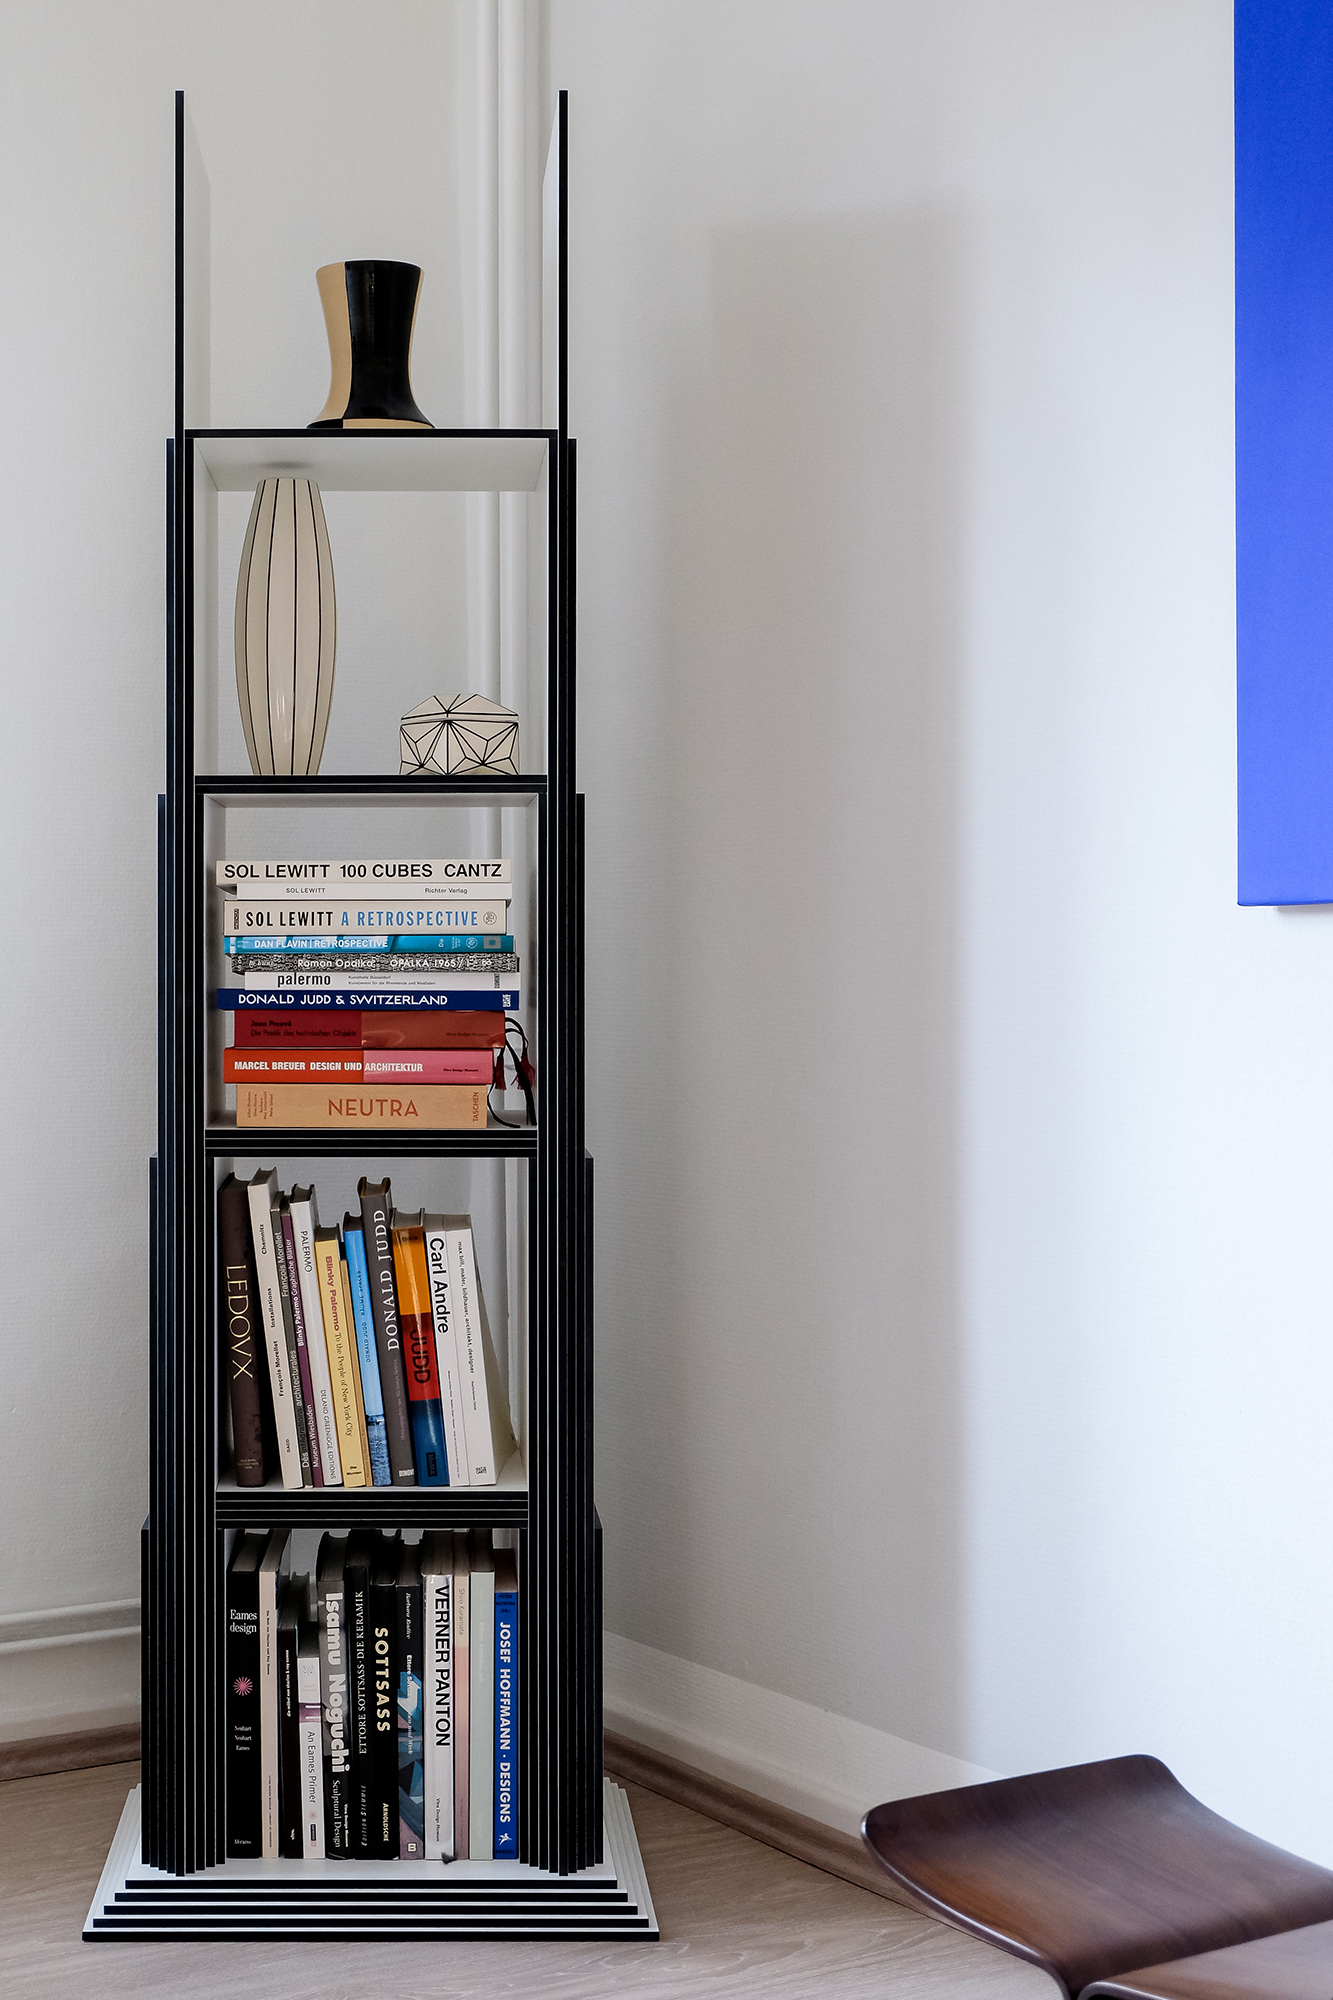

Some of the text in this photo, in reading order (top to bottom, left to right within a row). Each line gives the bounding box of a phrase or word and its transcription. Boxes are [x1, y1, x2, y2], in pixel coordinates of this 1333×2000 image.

[224, 863, 502, 878] SOL LEWITT 100 CUBES CANTZ
[448, 887, 468, 895] Verlag
[245, 911, 274, 927] SOL
[279, 911, 334, 927] LEWITT
[341, 911, 350, 926] A
[357, 910, 479, 926] RETROSPECTIVE
[254, 940, 275, 949] DAN
[275, 940, 310, 949] FLAVIN
[314, 939, 389, 948] RETROSPECTIVE
[297, 958, 374, 969] Roman Opalka
[390, 959, 430, 968] OPALKA
[238, 994, 448, 1006] DONALD JUDD & SWITZERLAND
[277, 972, 331, 988] palermo
[250, 1020, 292, 1028] Jean Prouvé
[332, 1030, 357, 1038] Objekts
[234, 1061, 424, 1072] MARCEL BREUER DESIGN UND ARCHITEKTUR
[328, 1098, 419, 1117] NEUTRA
[274, 1231, 289, 1298] François Morellet
[300, 1230, 313, 1273] PALERMO
[285, 1238, 305, 1348] Blinky Palermo Graphische Blätter
[373, 1210, 400, 1351] DONALD JUDD
[429, 1237, 451, 1334] Carl Andre
[259, 1223, 285, 1397] François Morellet Installations Chemnitz
[462, 1287, 470, 1318] bildhauer,
[325, 1255, 353, 1437] Blinky Palermo To the People of New York City
[464, 1317, 473, 1348] architekt,
[409, 1329, 431, 1384] JUDD
[467, 1347, 475, 1374] designer
[289, 1350, 303, 1407] architecturales
[306, 1404, 320, 1469] Museum Wiesbaden
[320, 1389, 329, 1415] DELANO
[327, 1450, 337, 1480] EDITIONS
[229, 1609, 258, 1621] Eames
[458, 1588, 466, 1605] Shiro
[229, 1622, 257, 1635] design
[325, 1592, 351, 1773] Isamu Noguchi
[354, 1590, 368, 1755] ETTORE SOTTSASS DIE KERAMIK
[374, 1627, 391, 1732] SOTTSASS
[434, 1584, 451, 1747] VERNER PANTON
[499, 1621, 512, 1823] JOSEF HOFFMANN DESIGNS
[307, 1730, 318, 1804] An Eames Primer
[331, 1779, 342, 1848] Sculptural Design
[382, 1802, 390, 1842] ARNOLDSCHE
